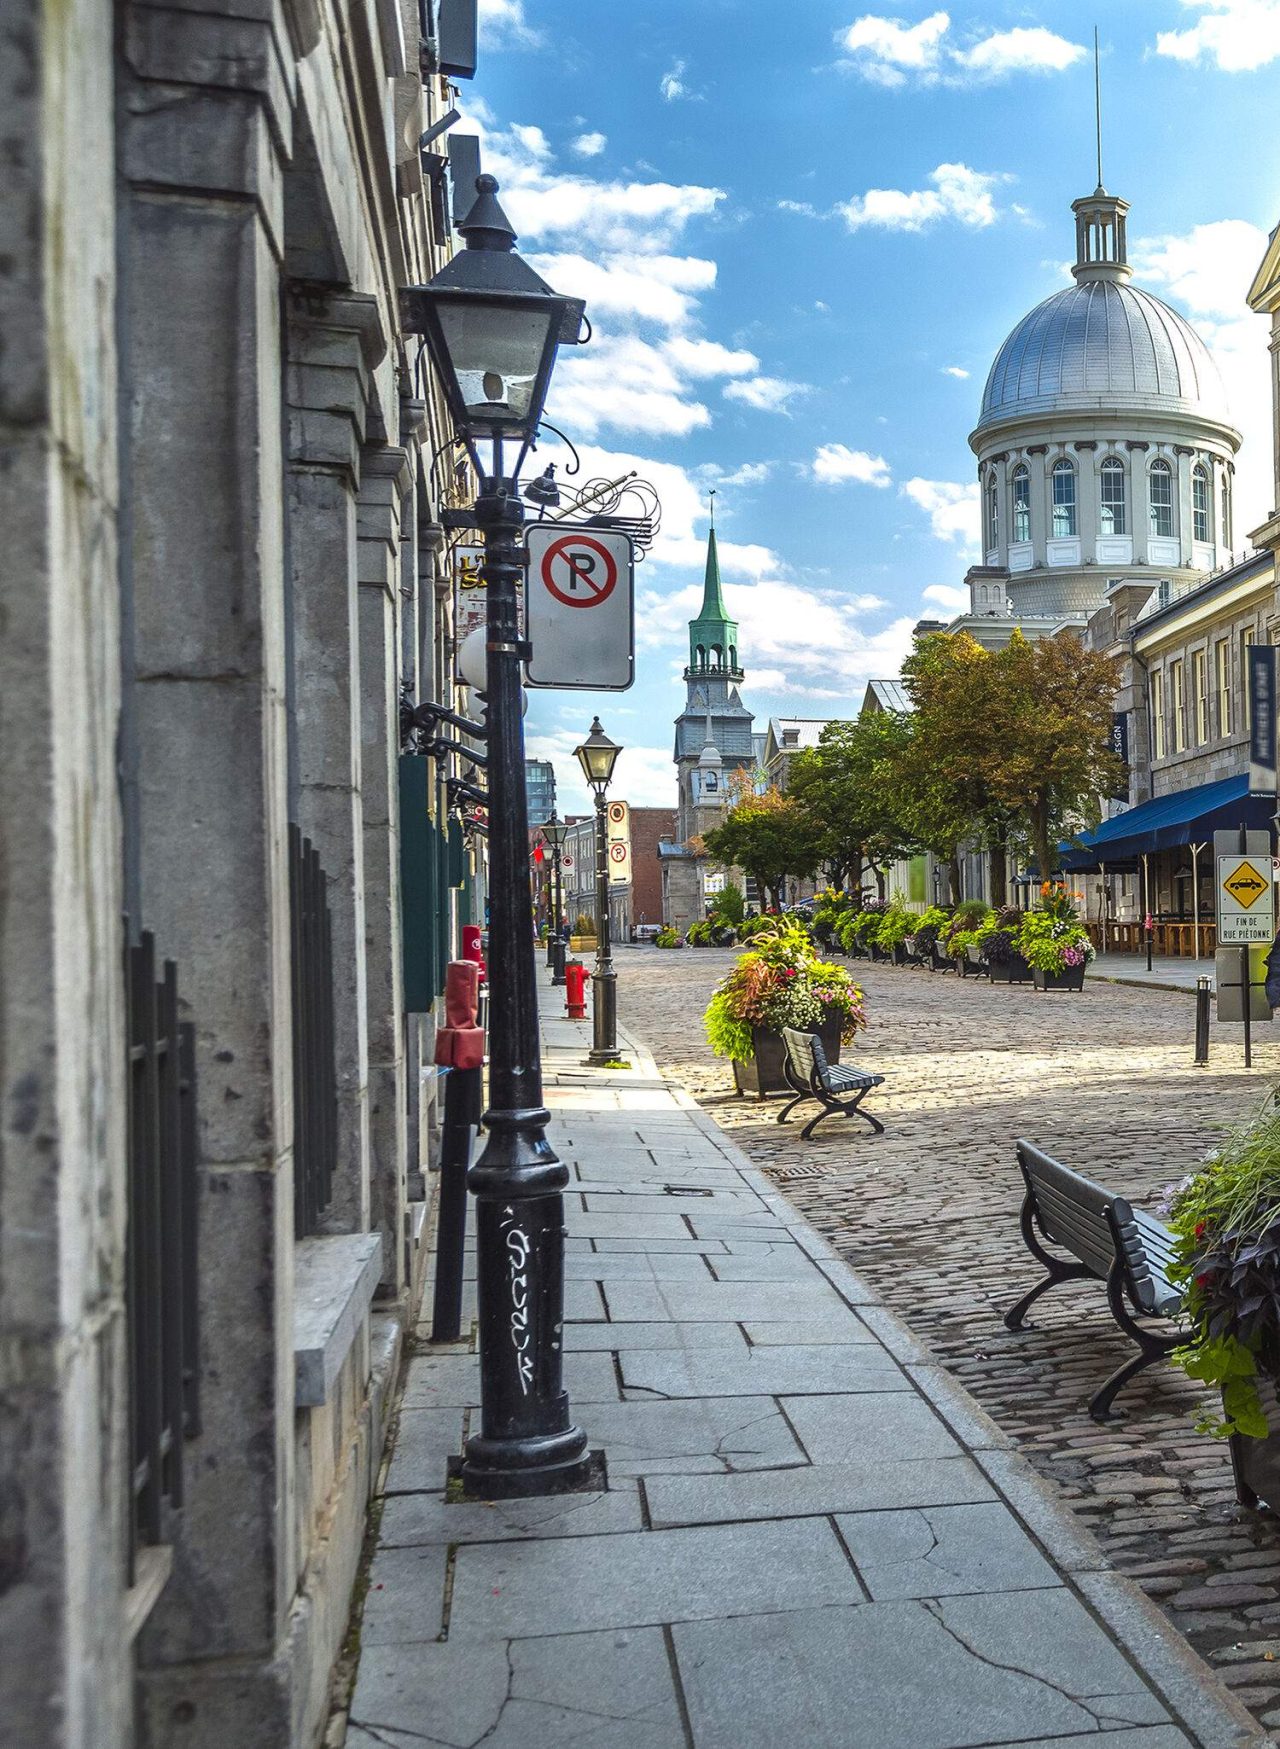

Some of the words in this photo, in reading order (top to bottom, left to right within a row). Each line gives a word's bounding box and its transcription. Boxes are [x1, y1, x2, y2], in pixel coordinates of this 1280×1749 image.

[1235, 917, 1247, 926] FIN
[1248, 917, 1257, 926] DE
[1223, 930, 1237, 939] RUE
